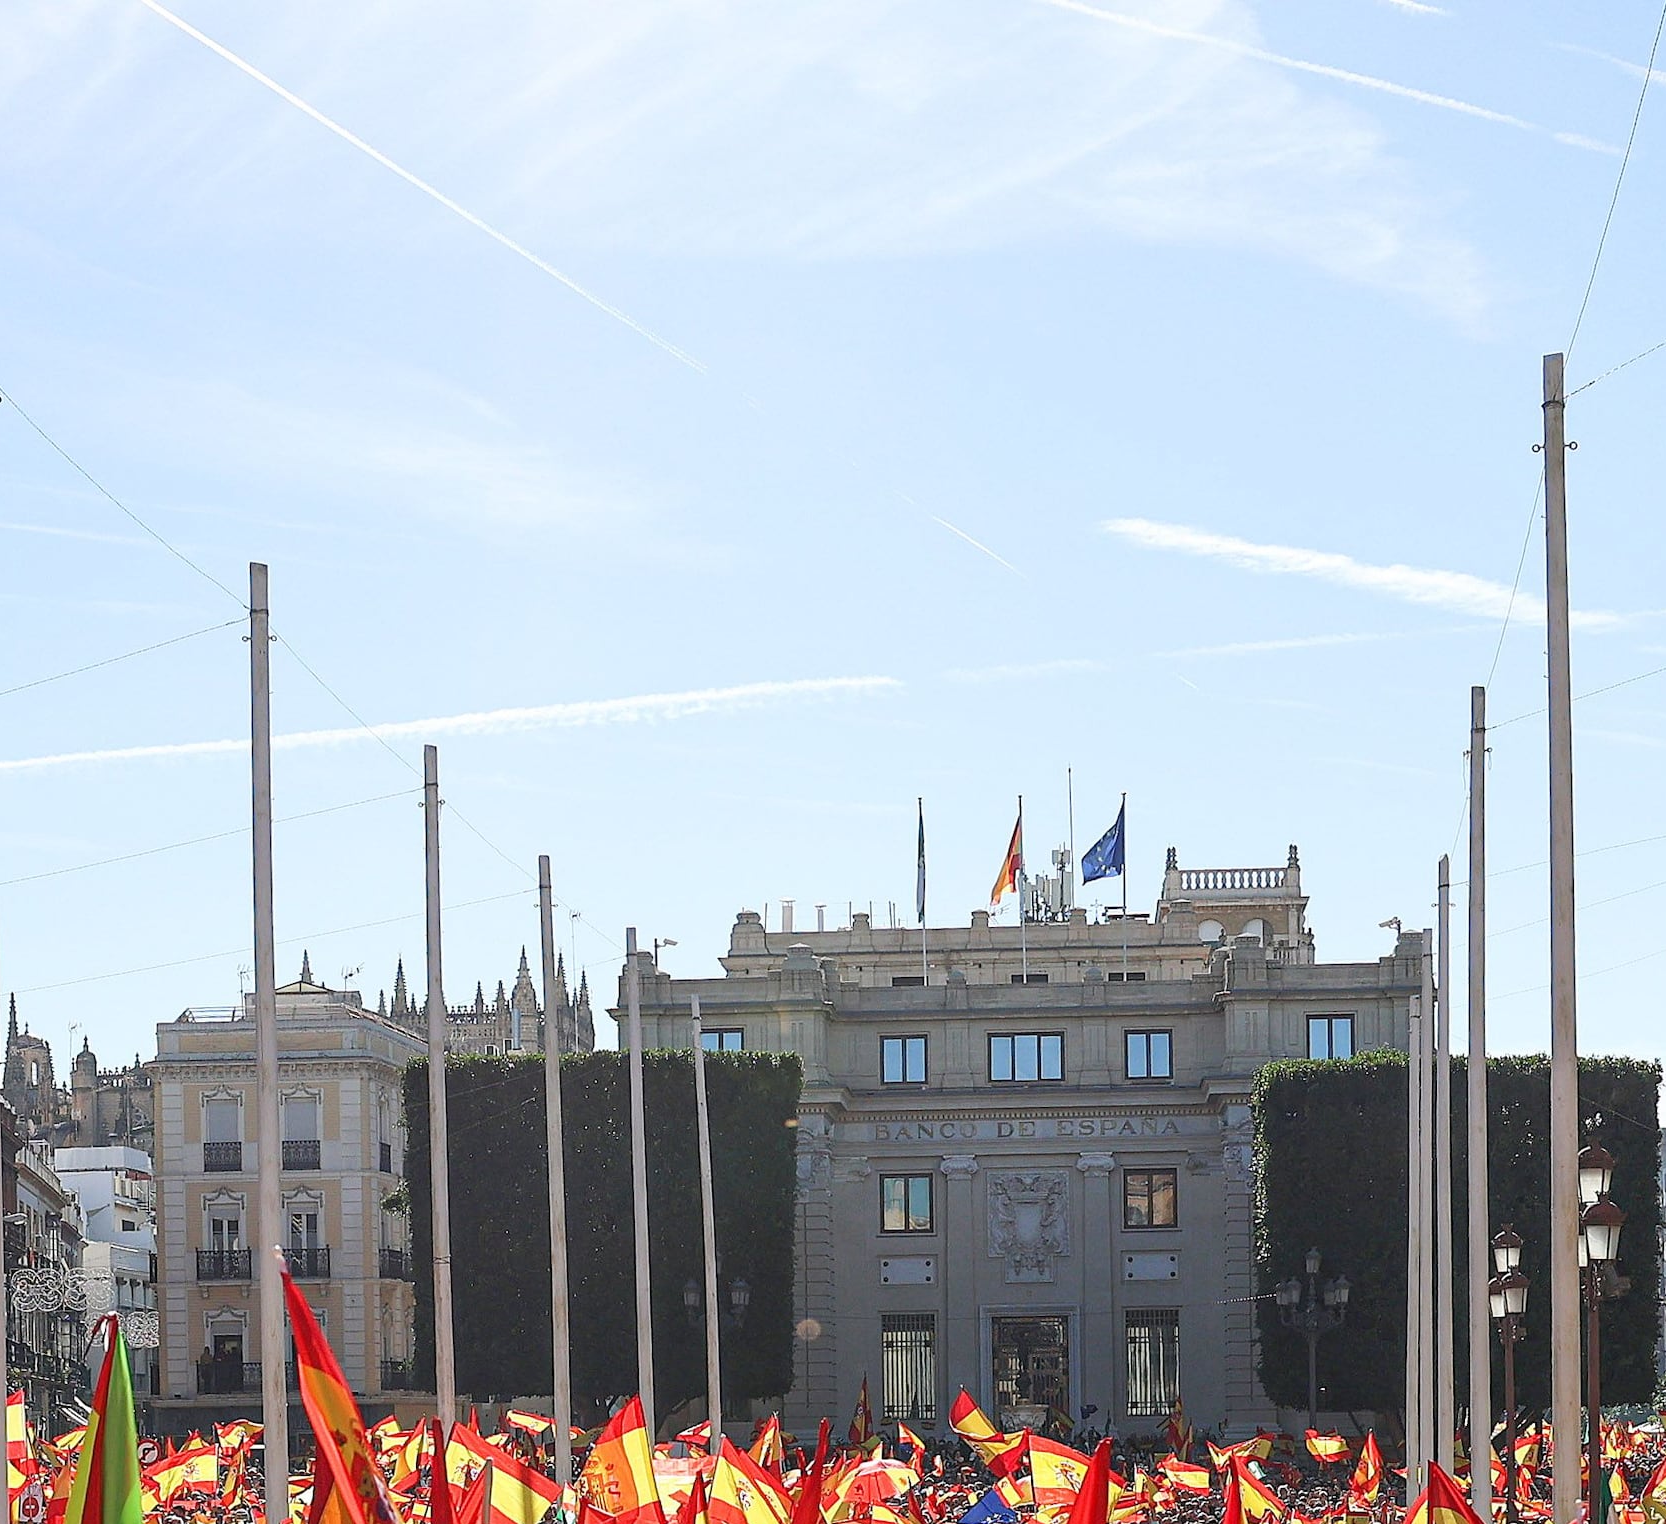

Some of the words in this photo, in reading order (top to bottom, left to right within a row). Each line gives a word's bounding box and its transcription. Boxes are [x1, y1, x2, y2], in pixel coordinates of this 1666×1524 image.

[874, 1121, 978, 1140] BANCO
[996, 1120, 1037, 1138] DE
[1056, 1116, 1182, 1137] ESPAÑA
